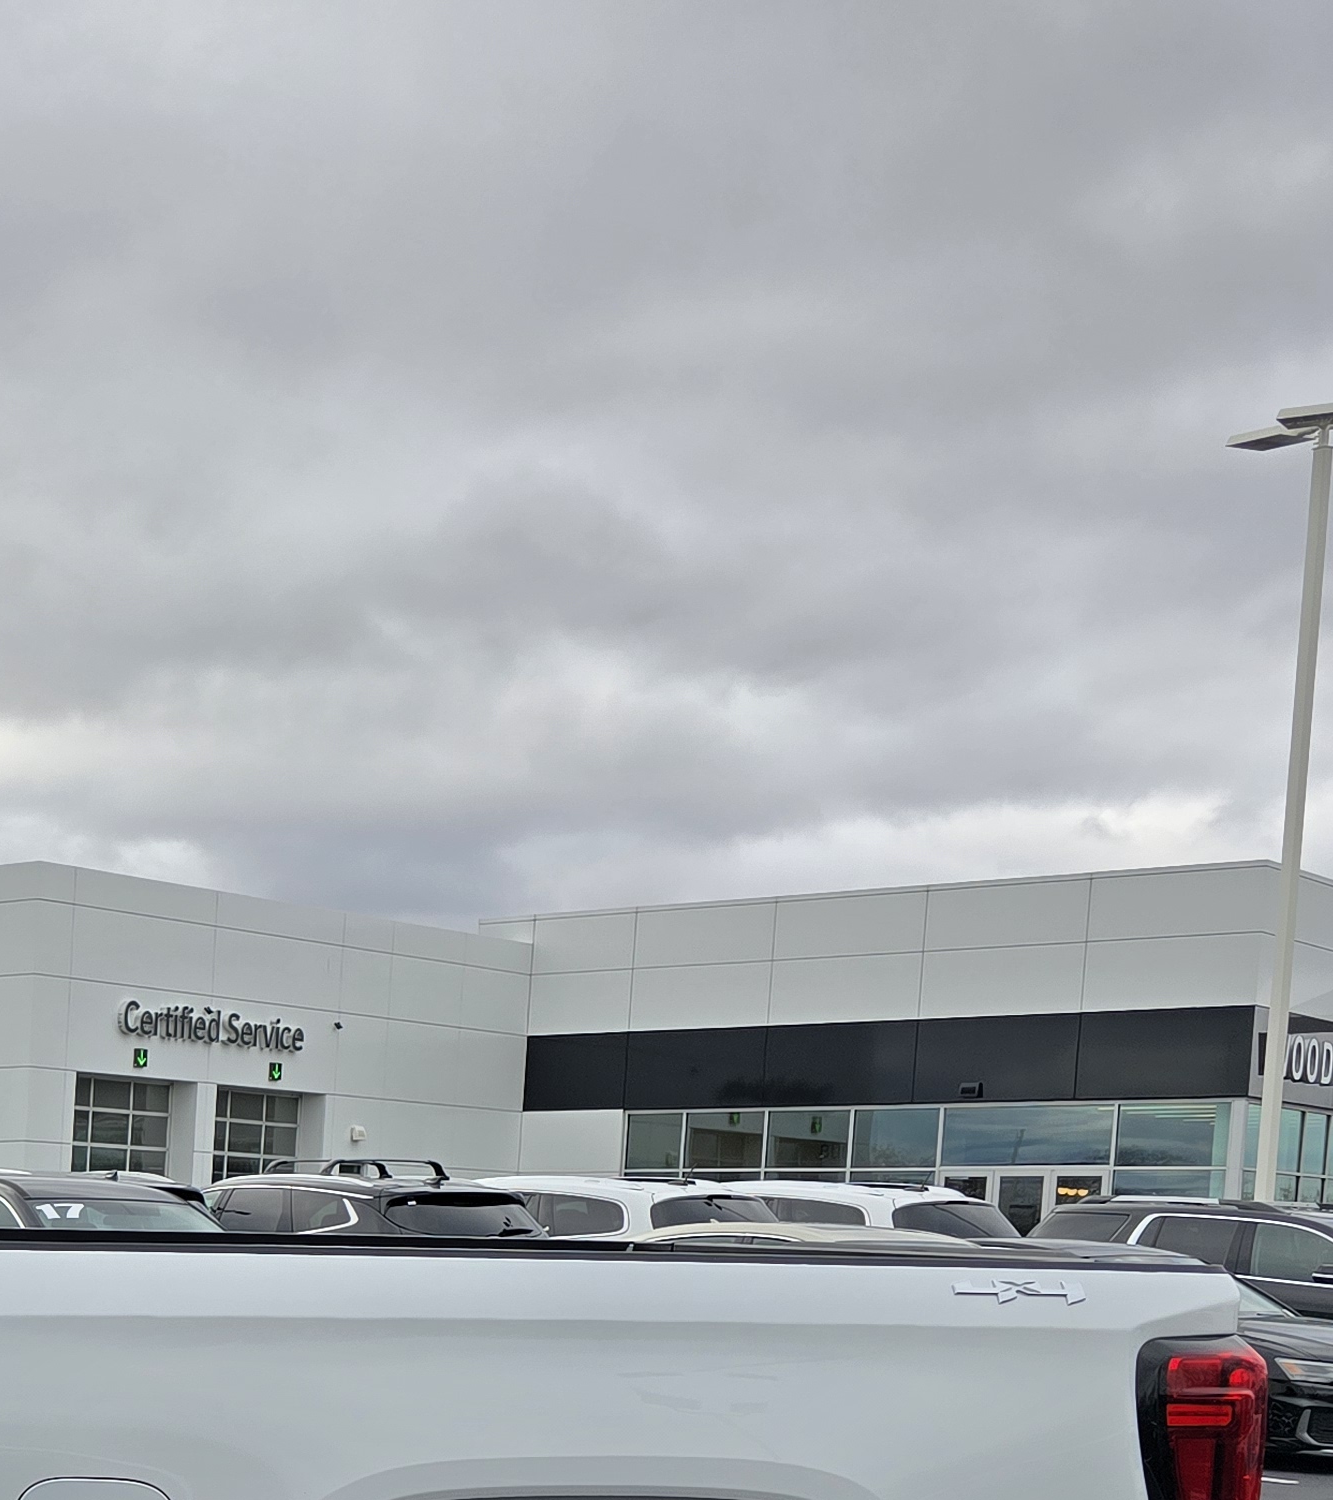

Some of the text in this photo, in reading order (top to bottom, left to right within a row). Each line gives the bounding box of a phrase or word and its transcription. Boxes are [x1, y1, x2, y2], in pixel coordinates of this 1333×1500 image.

[123, 1000, 305, 1051] Certified Service
[1283, 1034, 1333, 1085] OOD
[35, 1203, 85, 1219] 17
